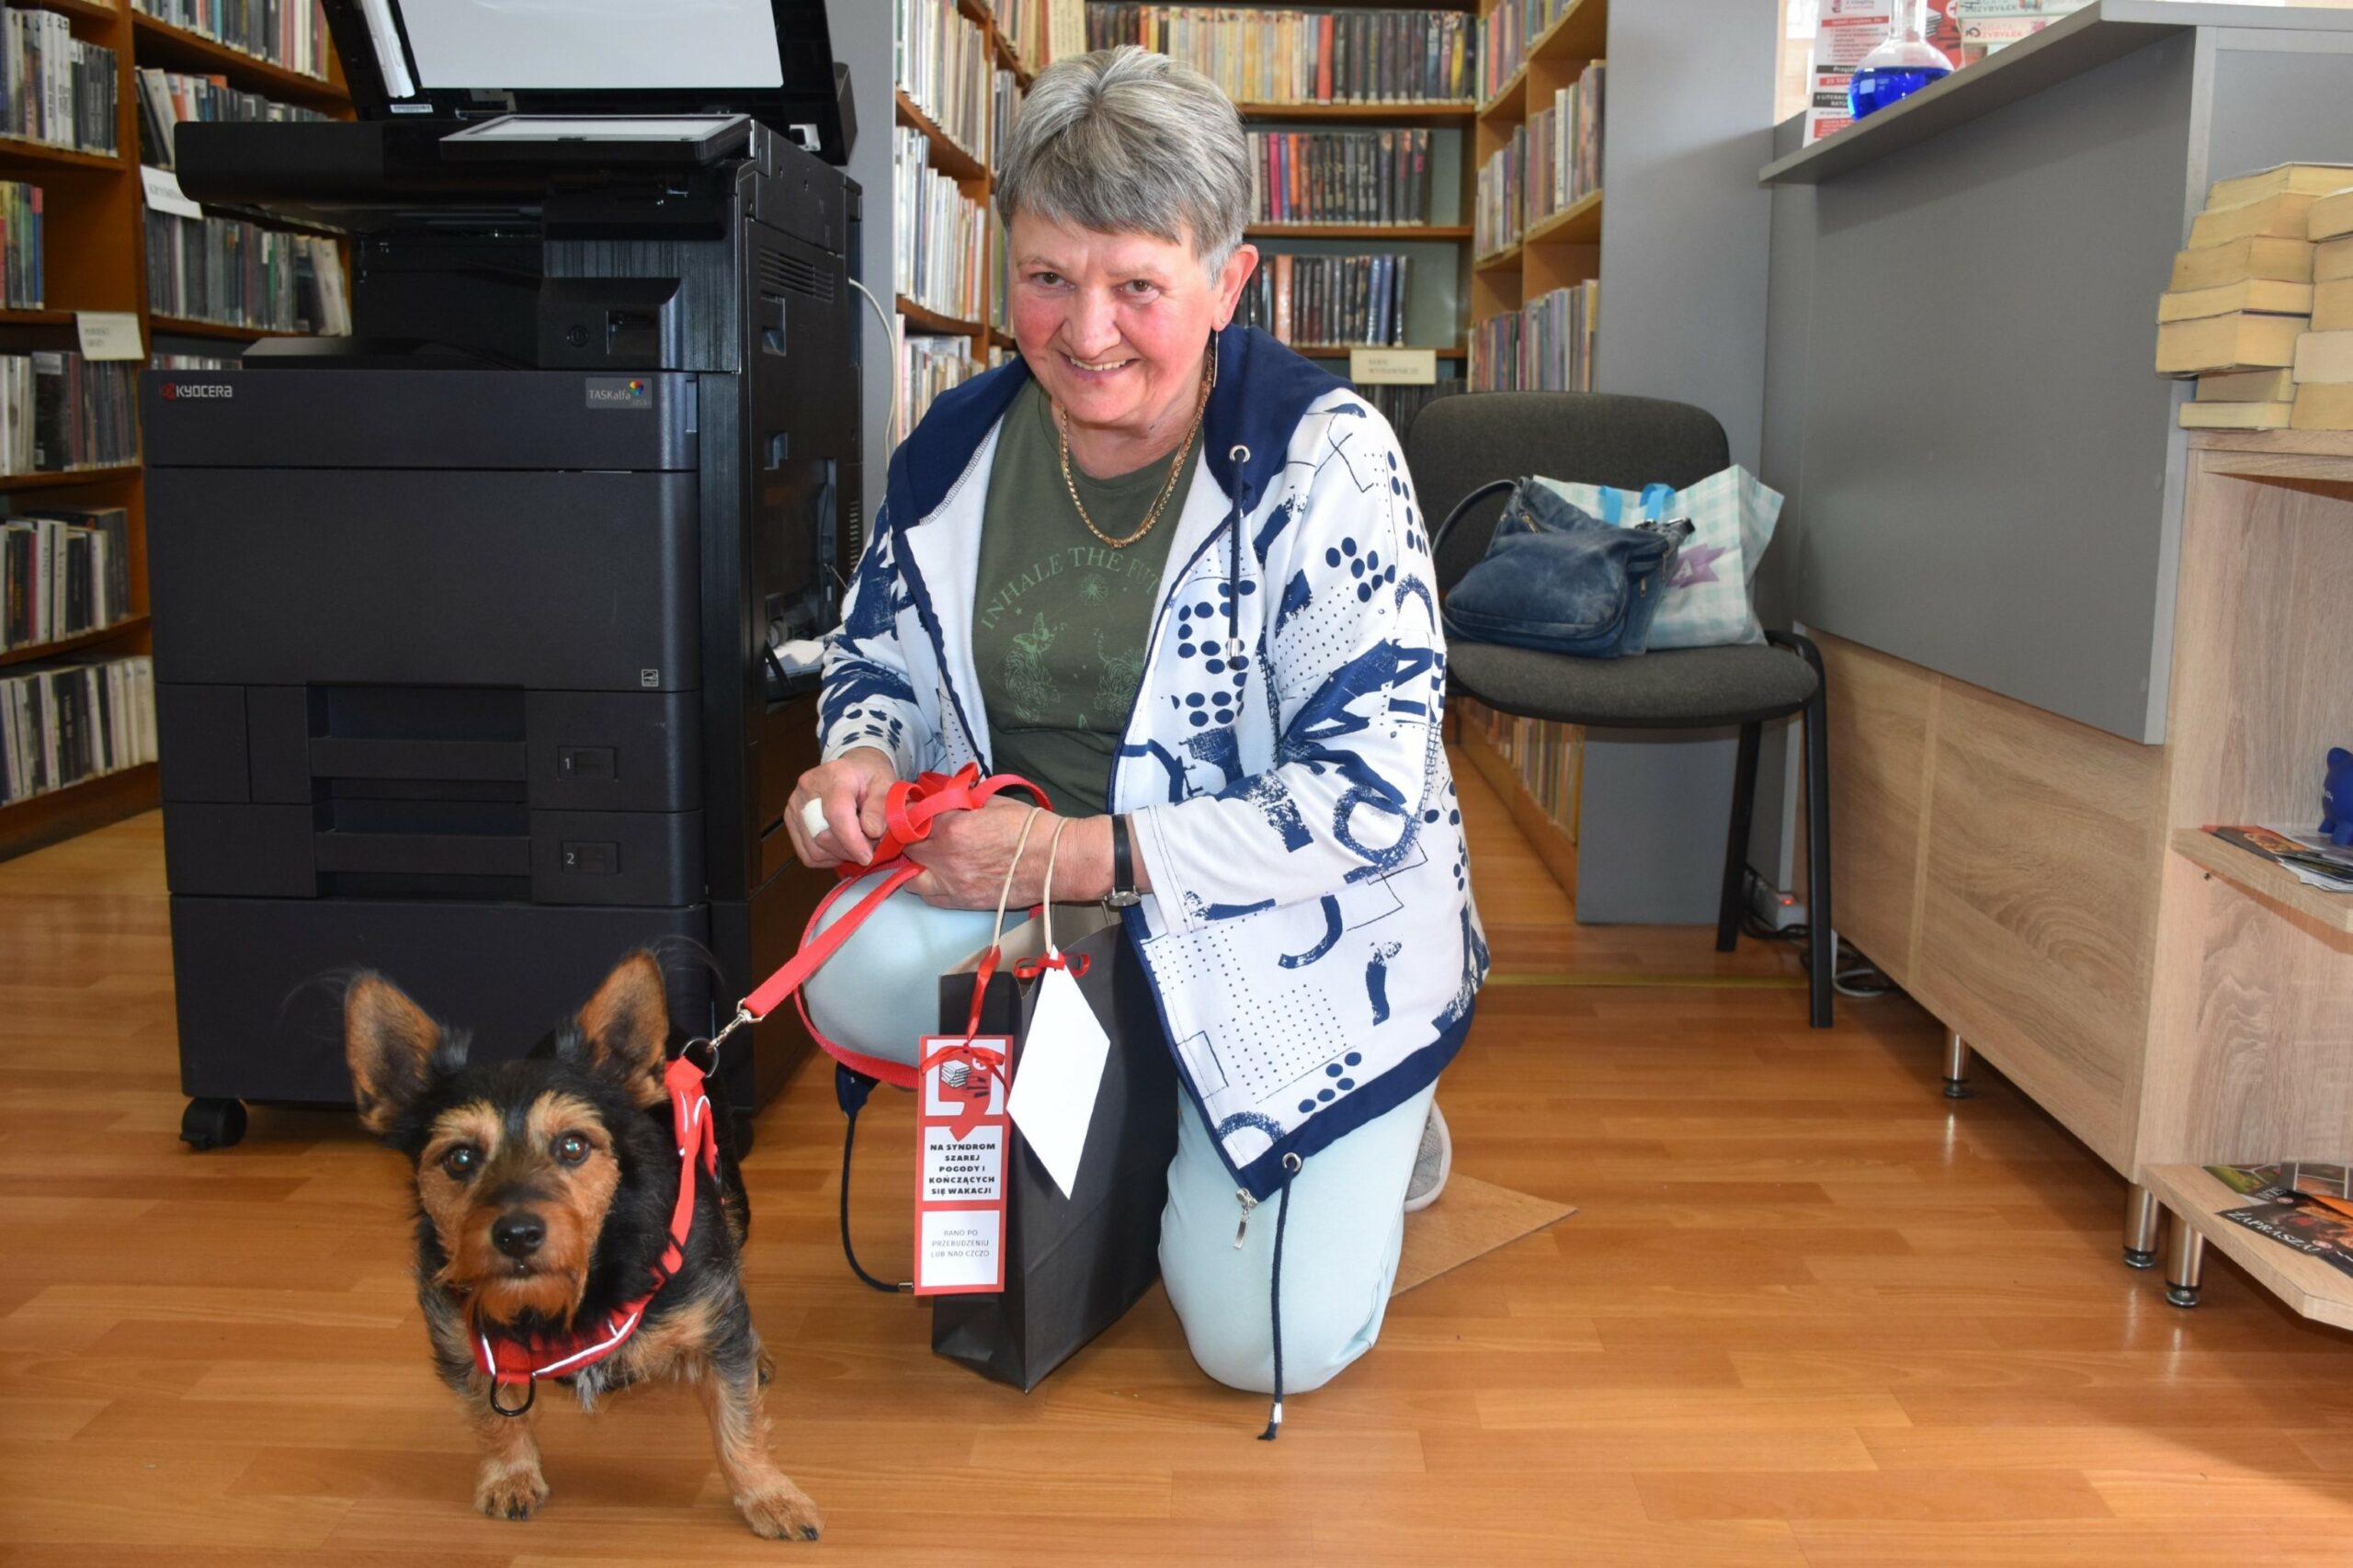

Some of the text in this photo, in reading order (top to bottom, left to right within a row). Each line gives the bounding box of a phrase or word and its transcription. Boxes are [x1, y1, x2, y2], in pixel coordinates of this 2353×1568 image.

[176, 385, 233, 398] KYOCERA
[589, 390, 631, 400] TASKalfa
[981, 553, 1063, 631] INHALE
[1068, 546, 1124, 573] THE
[564, 757, 571, 770] 1
[566, 852, 575, 865] 2
[928, 1176, 995, 1185] KOŃCZĄCYCH
[931, 1187, 945, 1196] SIĘ
[932, 1239, 989, 1247] PRZEBUDZENIU
